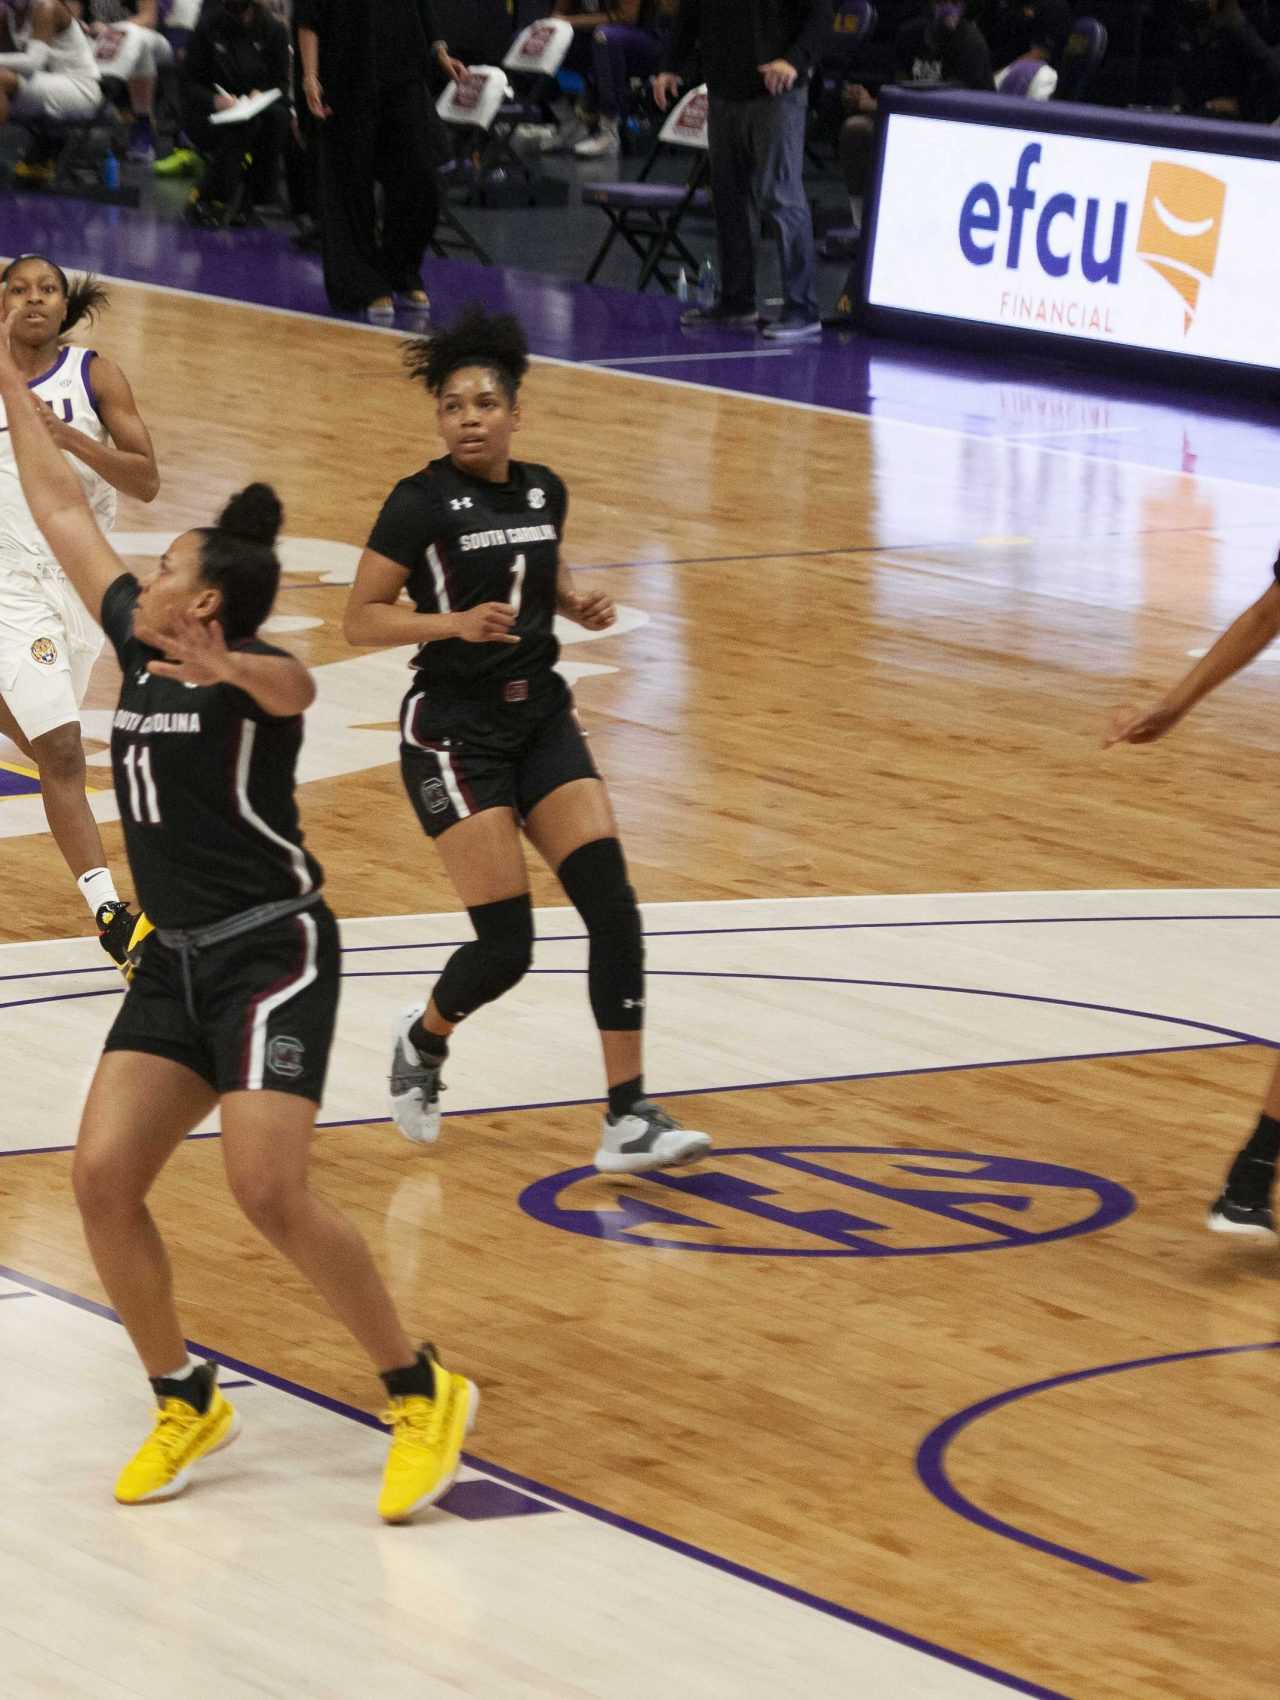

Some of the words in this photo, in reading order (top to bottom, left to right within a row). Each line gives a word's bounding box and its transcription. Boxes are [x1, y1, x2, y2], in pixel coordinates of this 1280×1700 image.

[958, 142, 1128, 285] efcu
[999, 291, 1115, 334] FINANCIAL
[459, 529, 507, 552] SOUTH
[509, 553, 527, 618] 1
[138, 712, 201, 734] OLINA
[122, 744, 162, 823] 11
